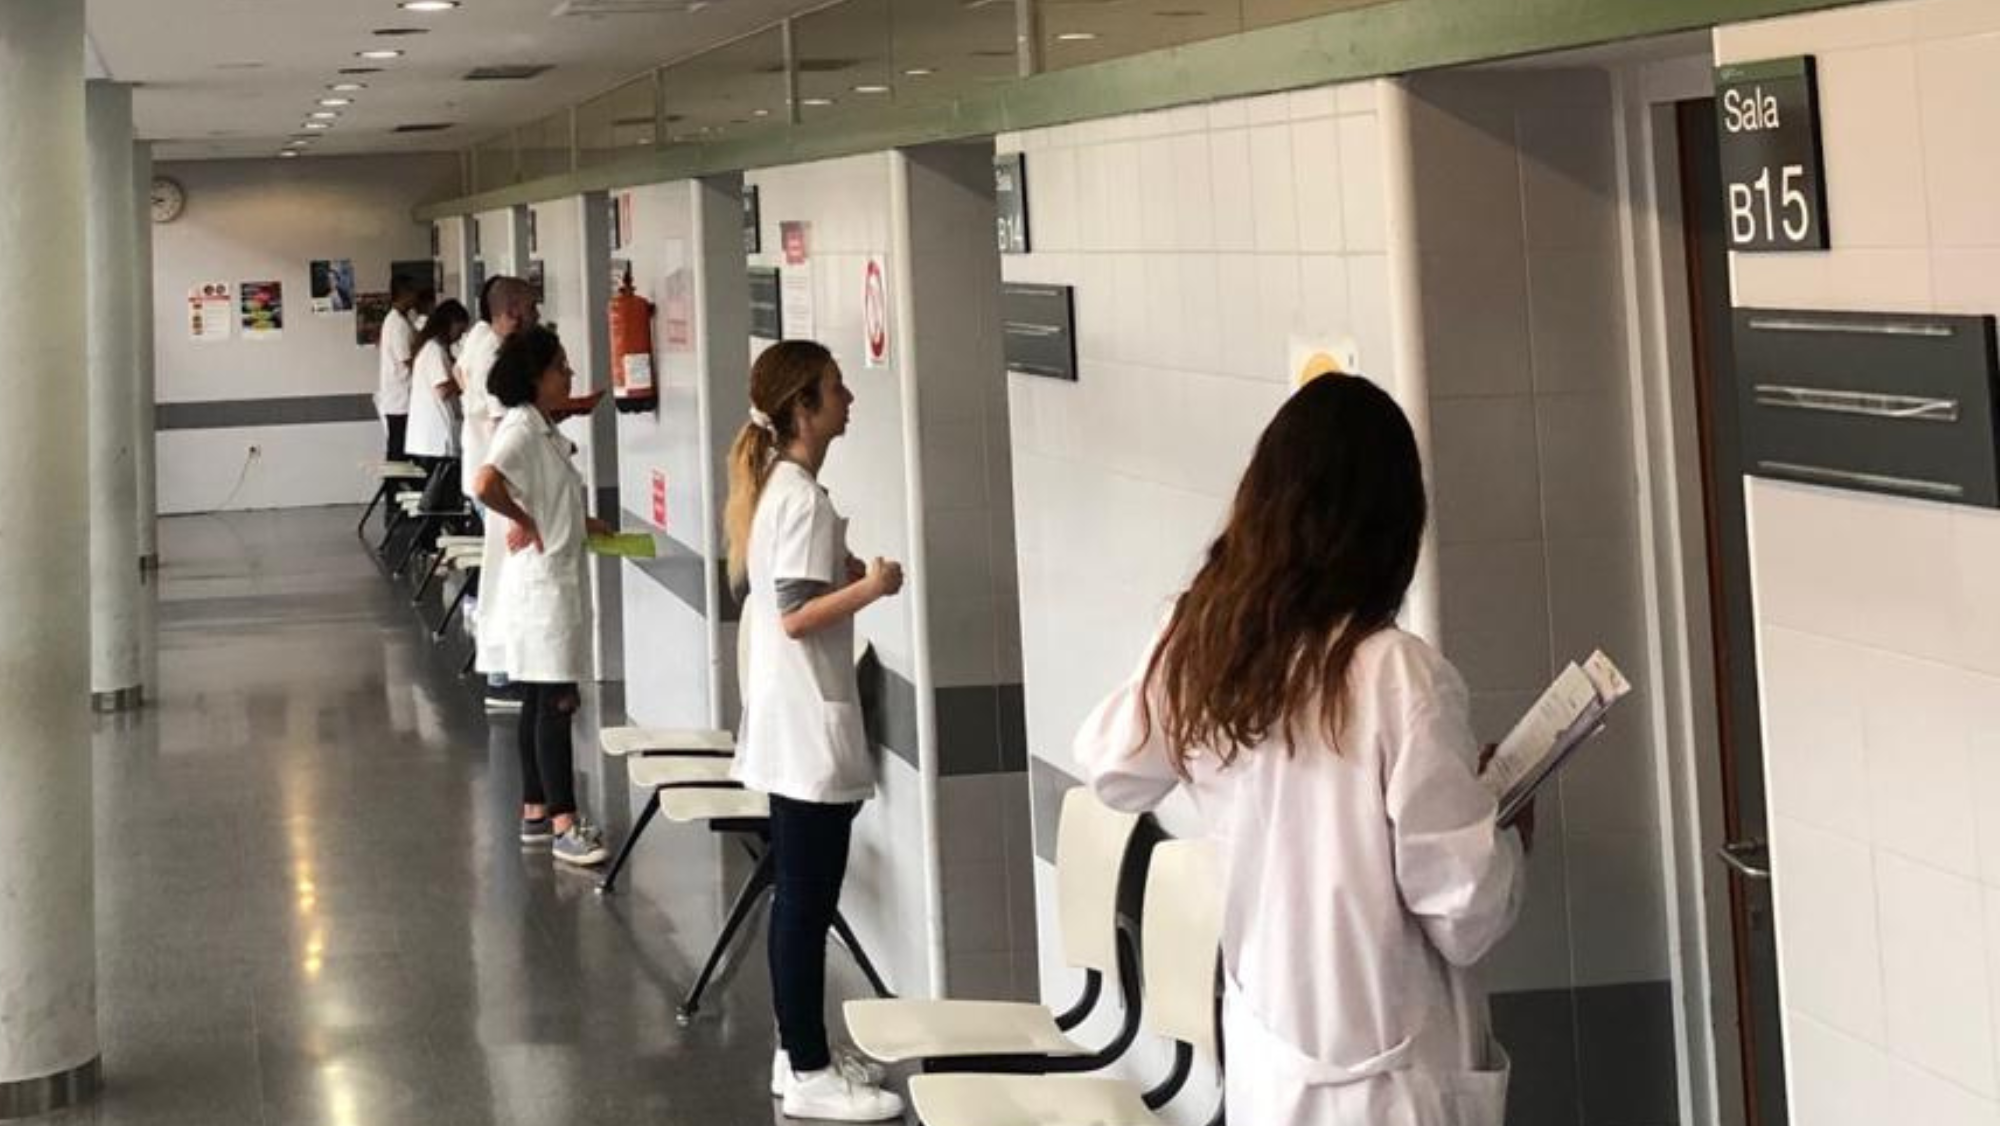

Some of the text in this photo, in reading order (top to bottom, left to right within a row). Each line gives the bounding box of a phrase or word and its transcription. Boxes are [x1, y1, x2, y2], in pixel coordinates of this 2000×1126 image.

[1724, 86, 1779, 132] Sala
[1729, 164, 1809, 243] B15
[997, 214, 1023, 250] B14
